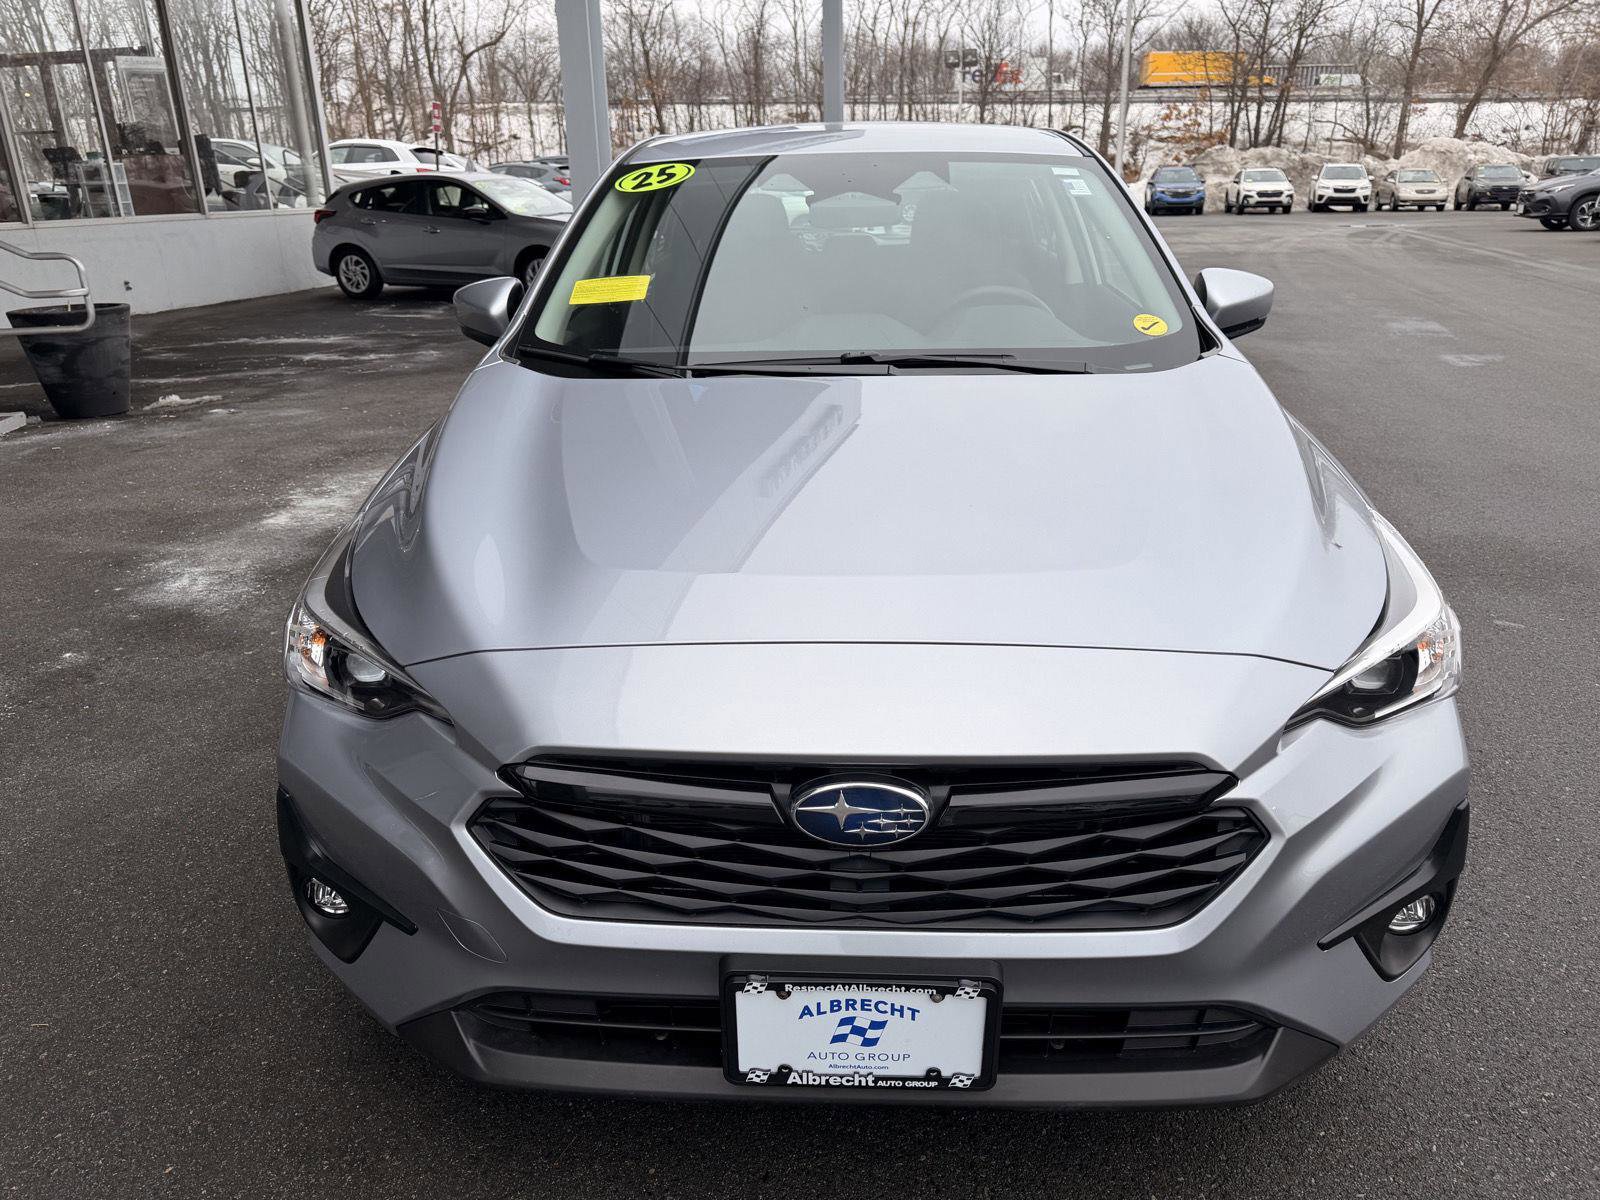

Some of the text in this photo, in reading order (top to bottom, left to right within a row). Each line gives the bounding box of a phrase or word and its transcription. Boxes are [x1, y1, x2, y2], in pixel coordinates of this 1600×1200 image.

[631, 165, 676, 190] 25
[785, 984, 937, 995] RespectAtAlbrecht.com
[798, 999, 920, 1021] ALBRECHT
[807, 1051, 911, 1062] AUTO GROUP
[787, 1071, 938, 1088] Albrecht AUTO GROUP
